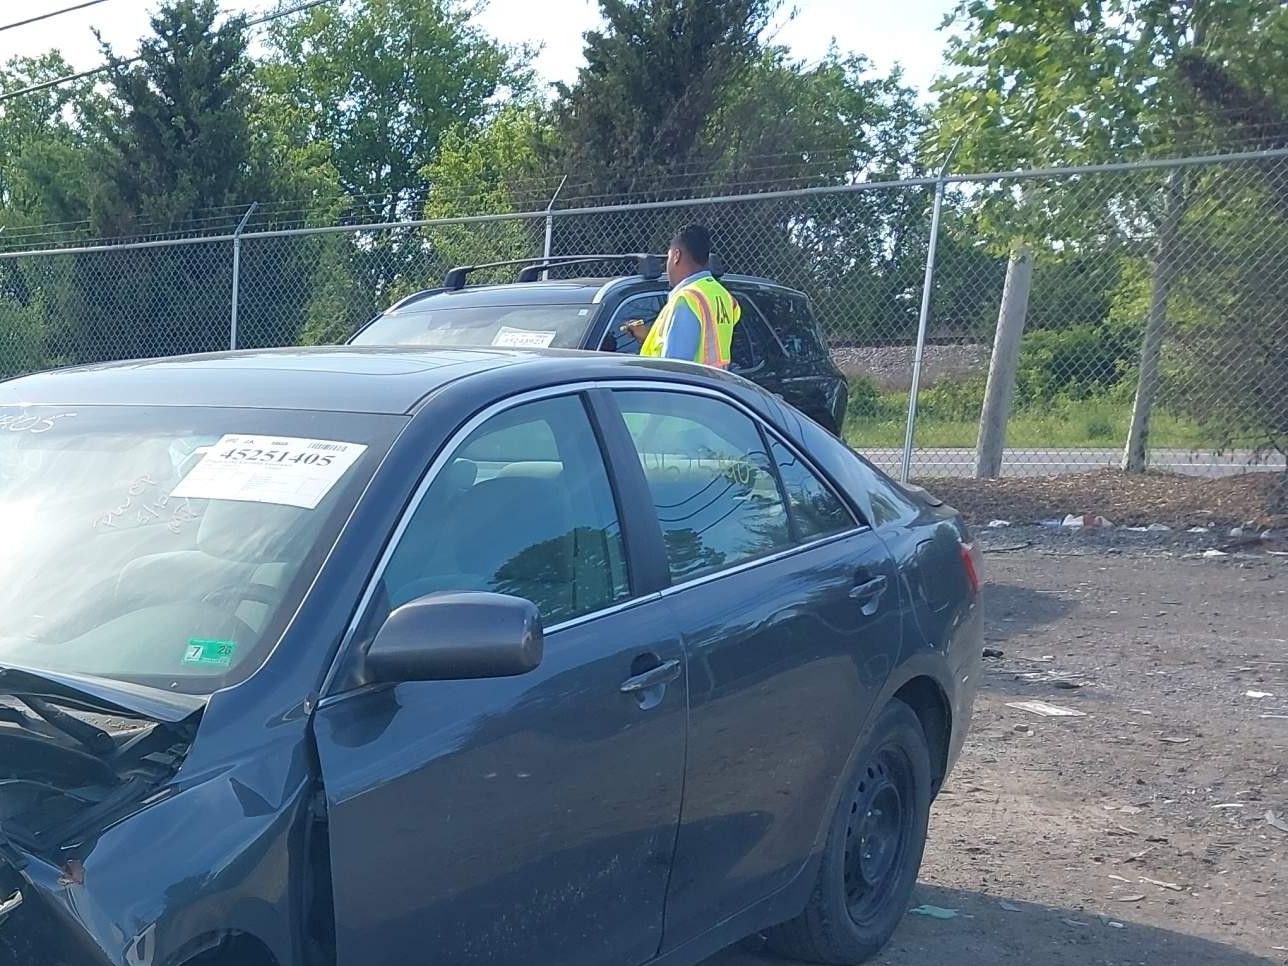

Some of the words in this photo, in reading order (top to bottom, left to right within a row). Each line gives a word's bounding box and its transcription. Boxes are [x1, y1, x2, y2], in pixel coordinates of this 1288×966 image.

[220, 448, 336, 467] 45251405
[193, 646, 201, 657] 7
[217, 645, 232, 655] 26
